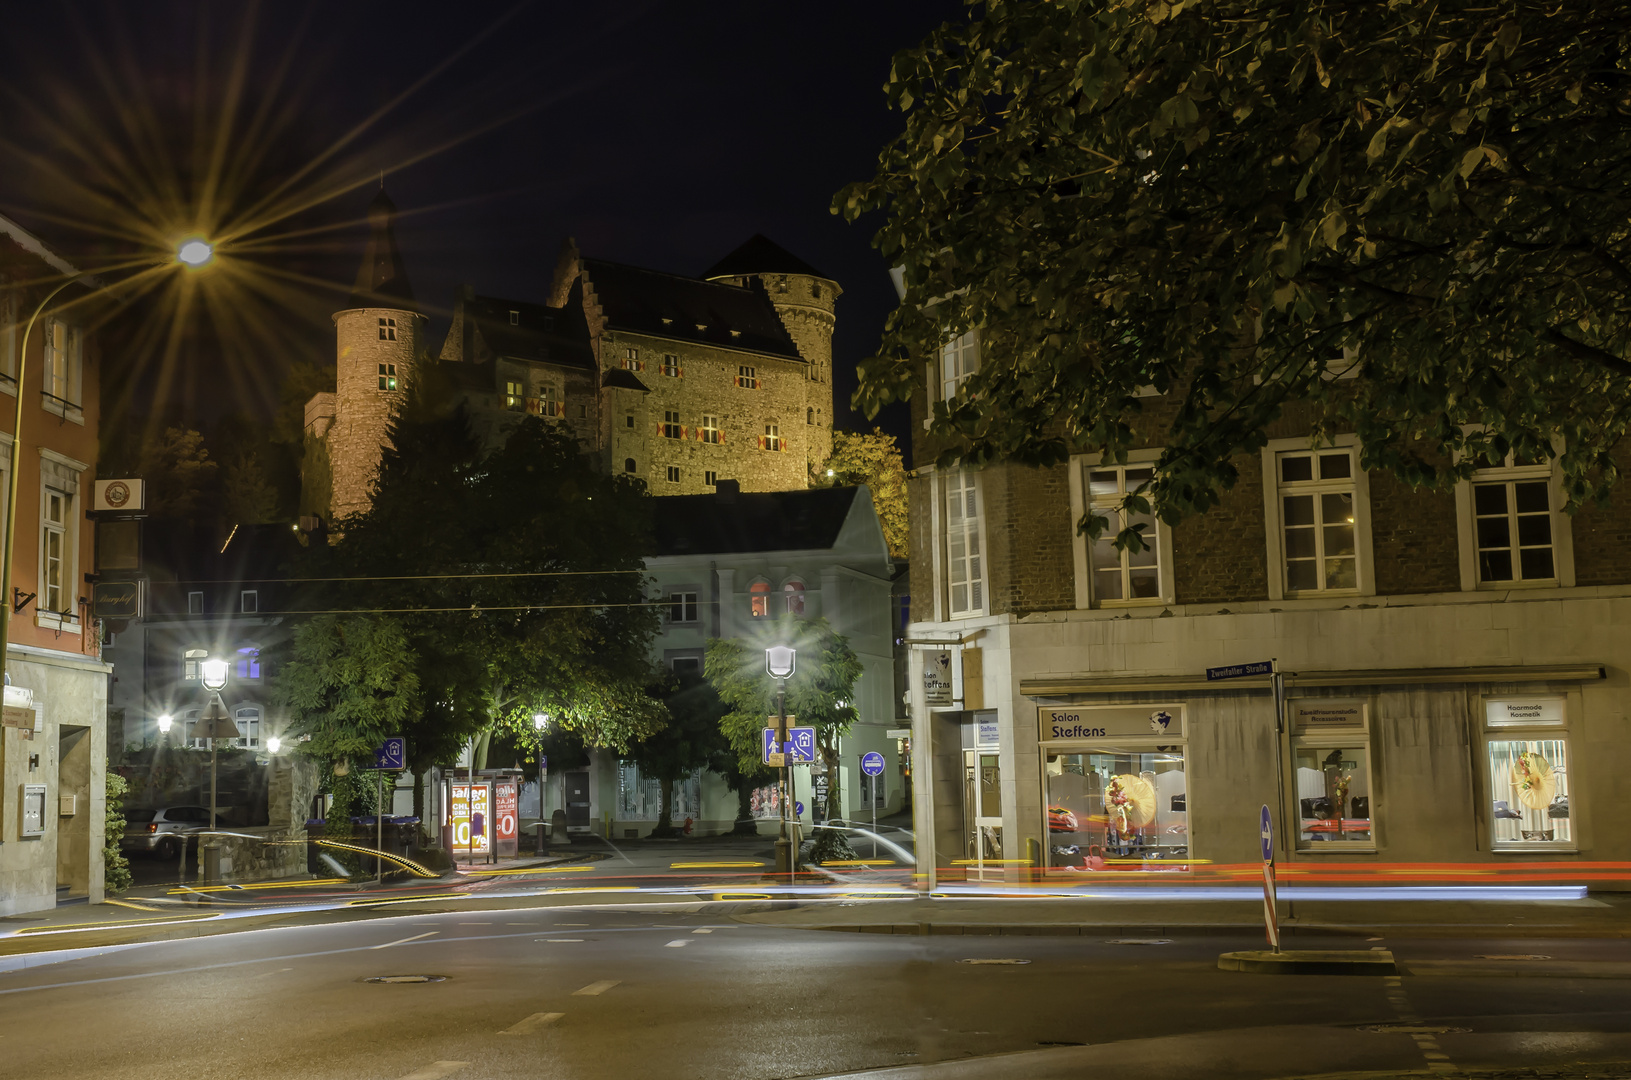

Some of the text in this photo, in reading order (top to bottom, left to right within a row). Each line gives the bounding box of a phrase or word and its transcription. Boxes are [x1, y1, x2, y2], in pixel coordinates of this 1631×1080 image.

[1211, 664, 1268, 678] Zweifaller Straße
[923, 680, 950, 688] teffens
[1051, 712, 1080, 722] Salon
[1052, 725, 1106, 738] Steffens
